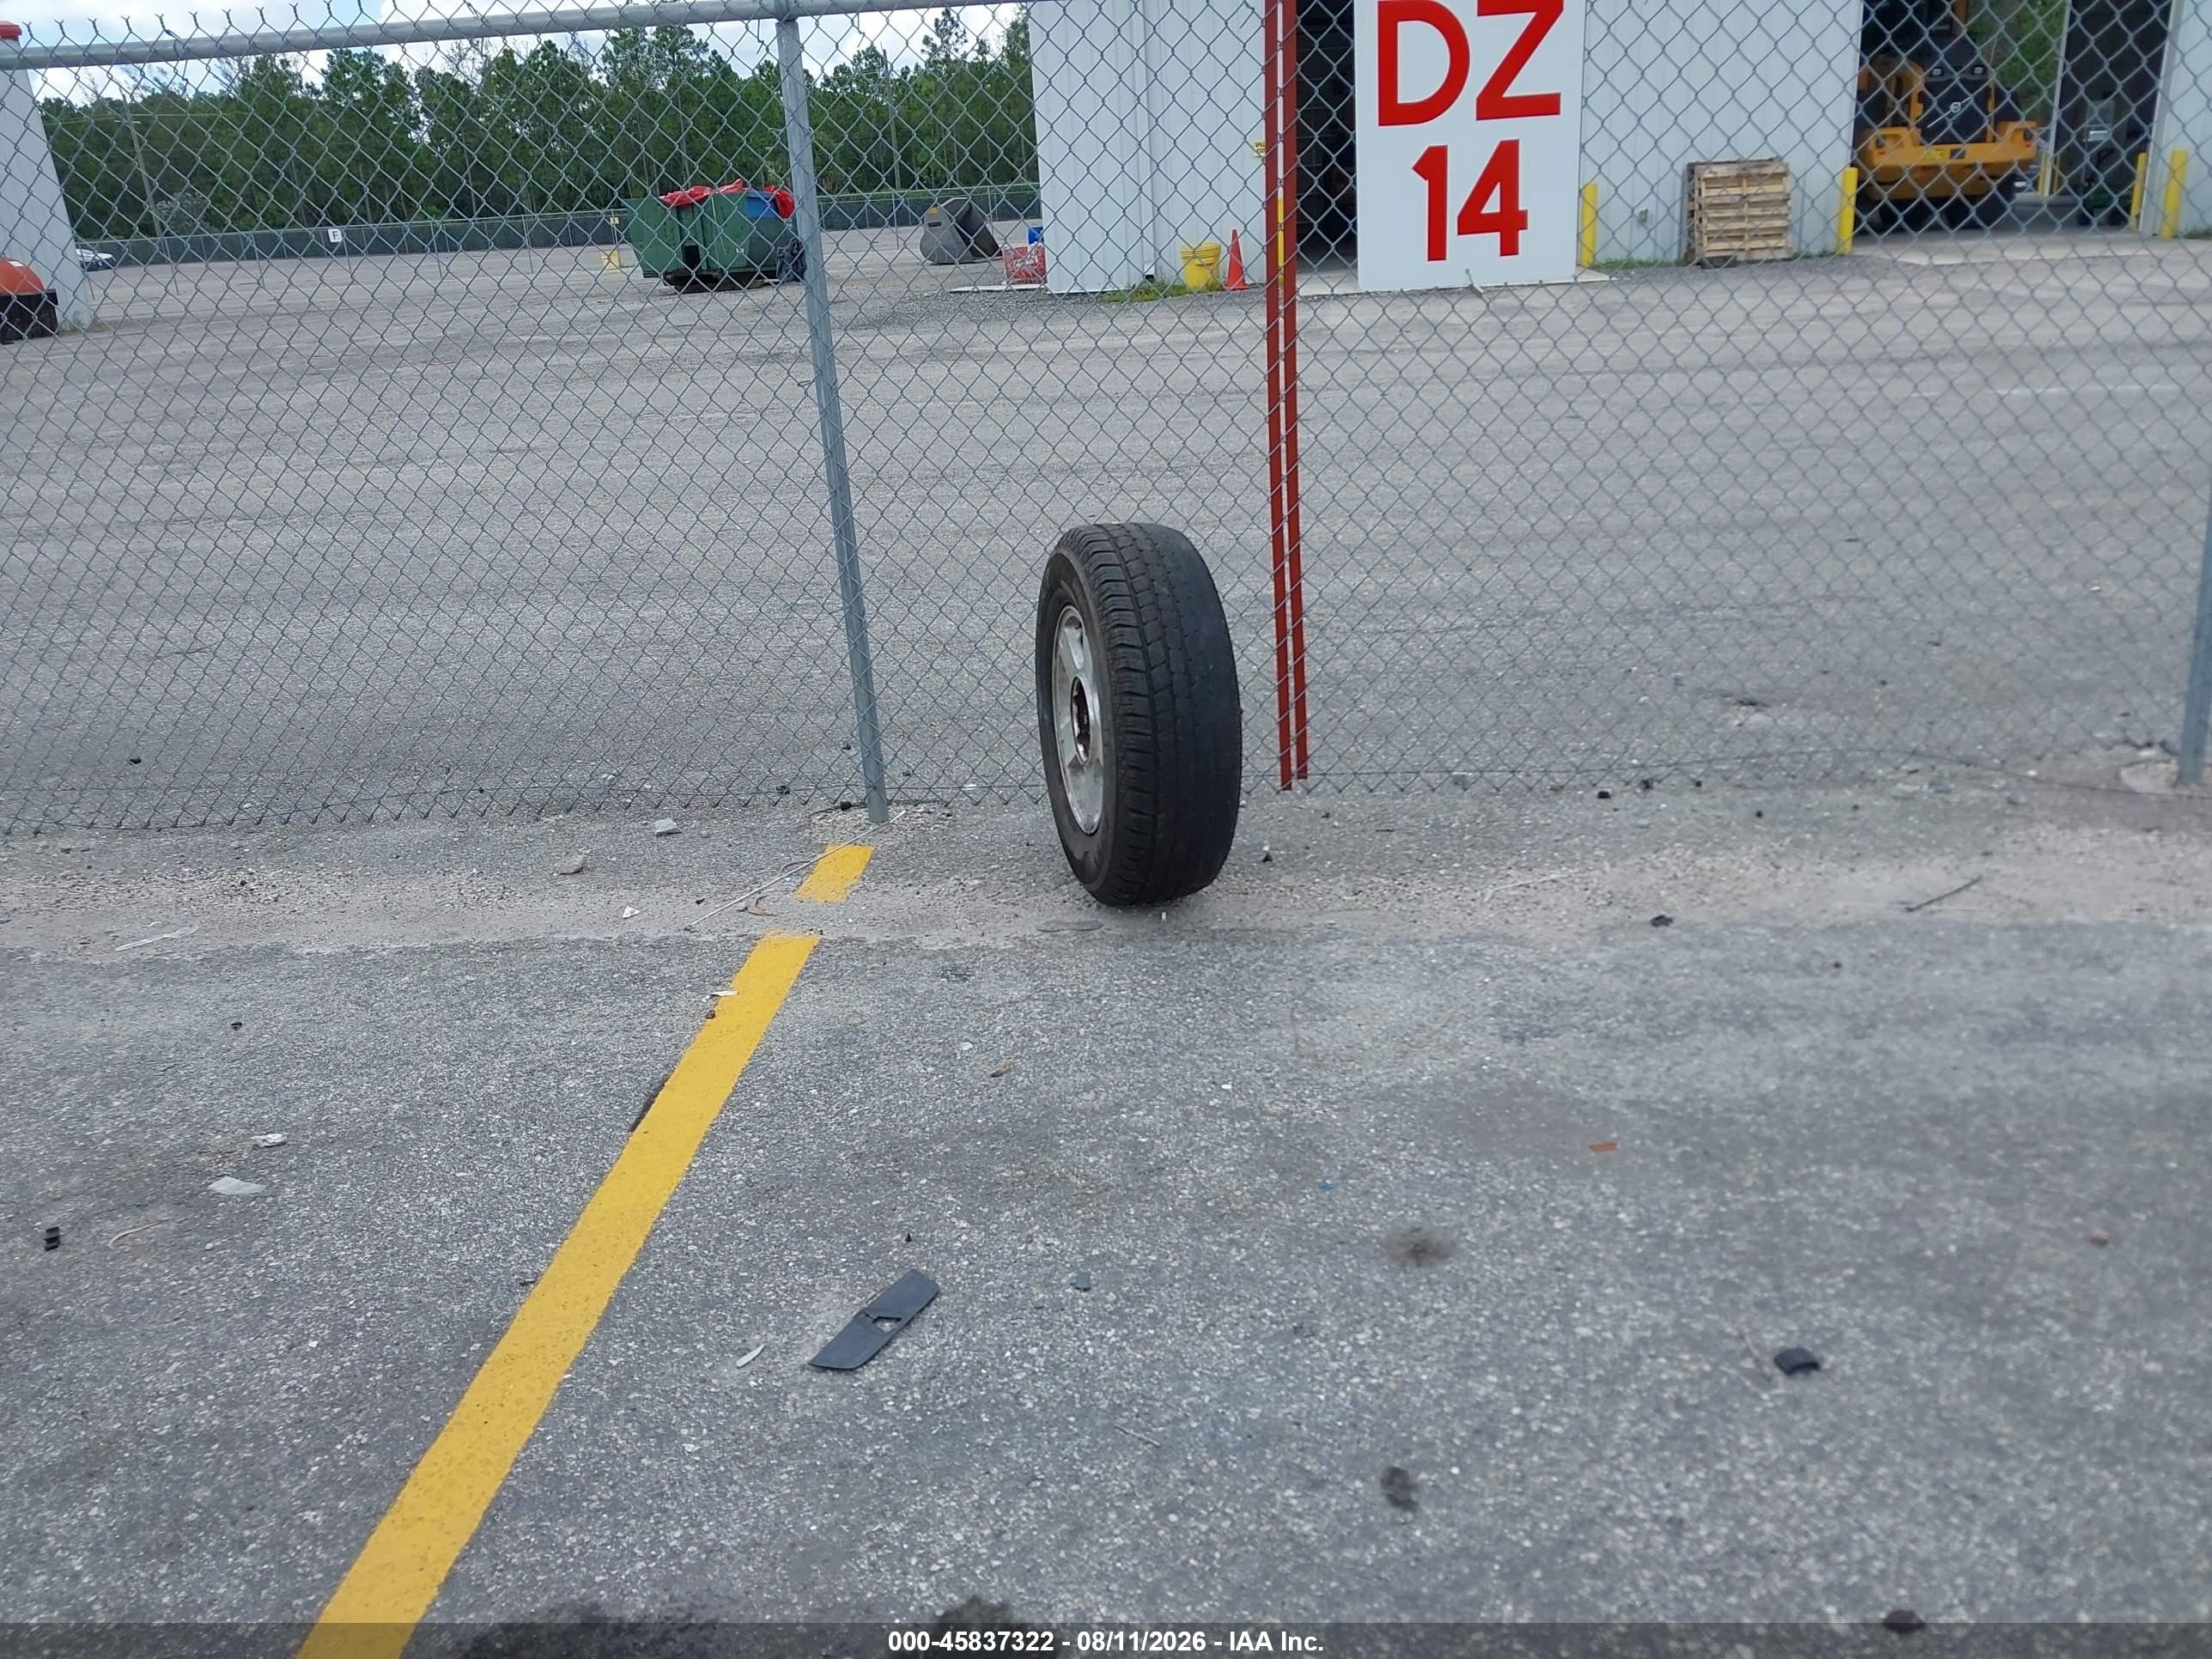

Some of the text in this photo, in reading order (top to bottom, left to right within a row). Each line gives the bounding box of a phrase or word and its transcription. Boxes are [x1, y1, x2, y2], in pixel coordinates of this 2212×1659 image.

[1377, 0, 1564, 126] DZ
[331, 230, 338, 240] F
[1412, 138, 1528, 261] 14
